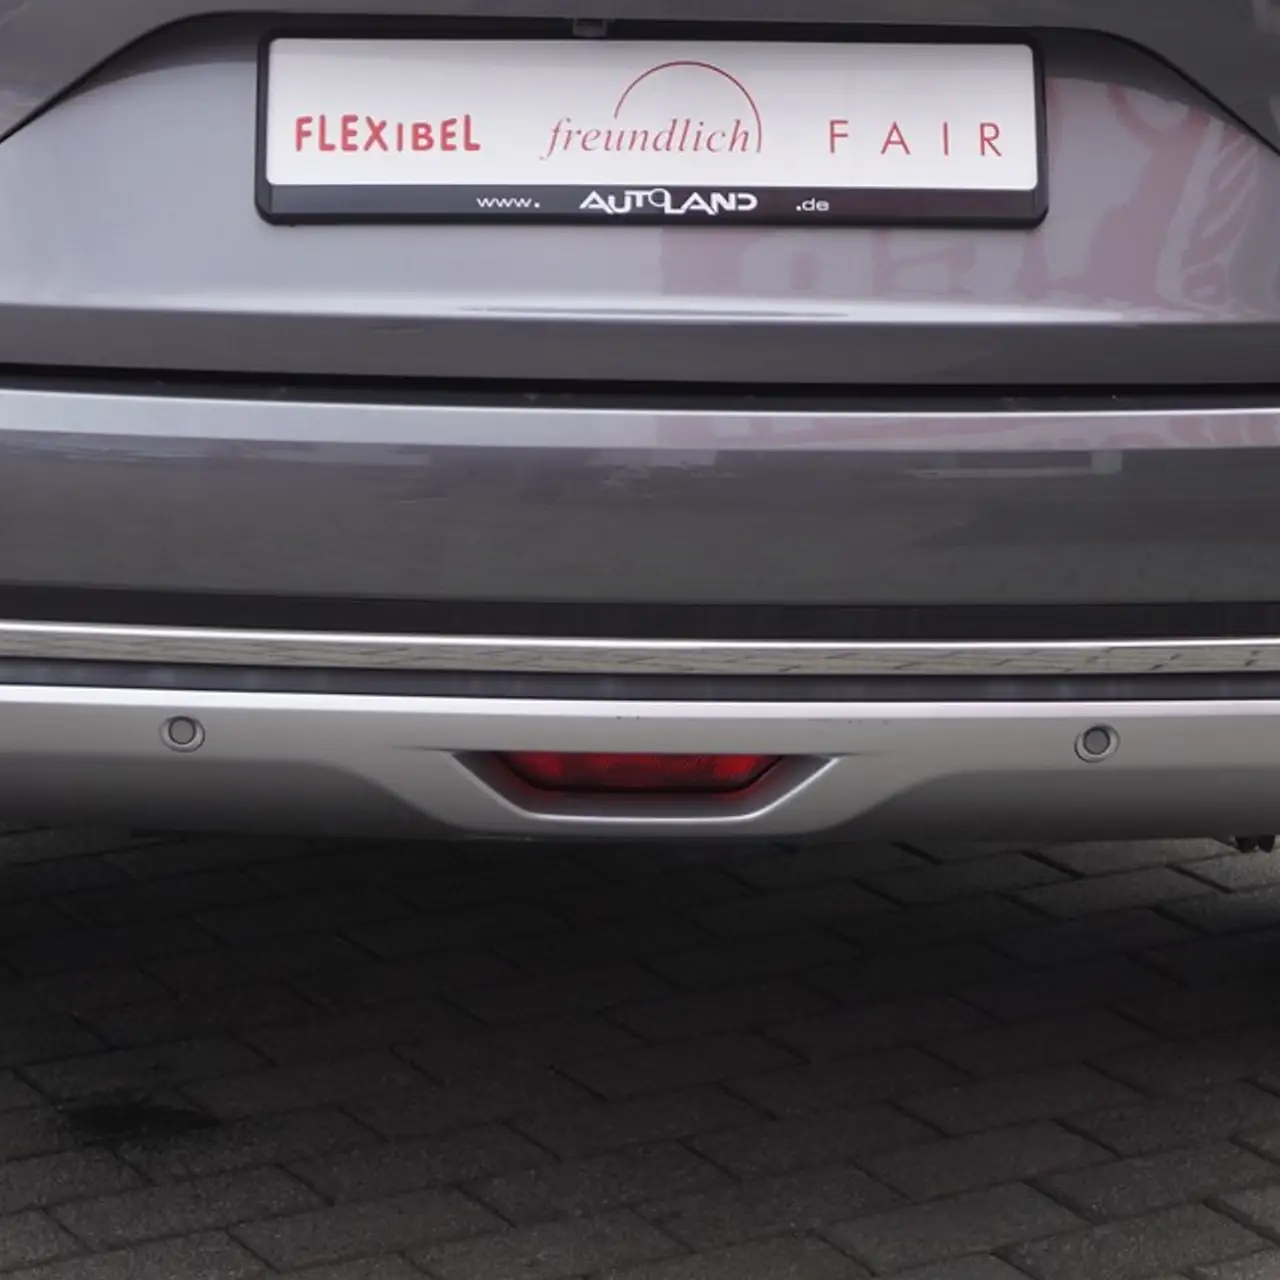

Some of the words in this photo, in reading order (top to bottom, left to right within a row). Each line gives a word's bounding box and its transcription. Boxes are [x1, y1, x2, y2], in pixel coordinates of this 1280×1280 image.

[294, 114, 481, 152] FLEXIBEL
[538, 117, 749, 161] freundlich
[829, 120, 1003, 156] FAIR
[477, 195, 541, 209] www.
[579, 188, 758, 215] AUTOLAND
[795, 198, 830, 212] .de
